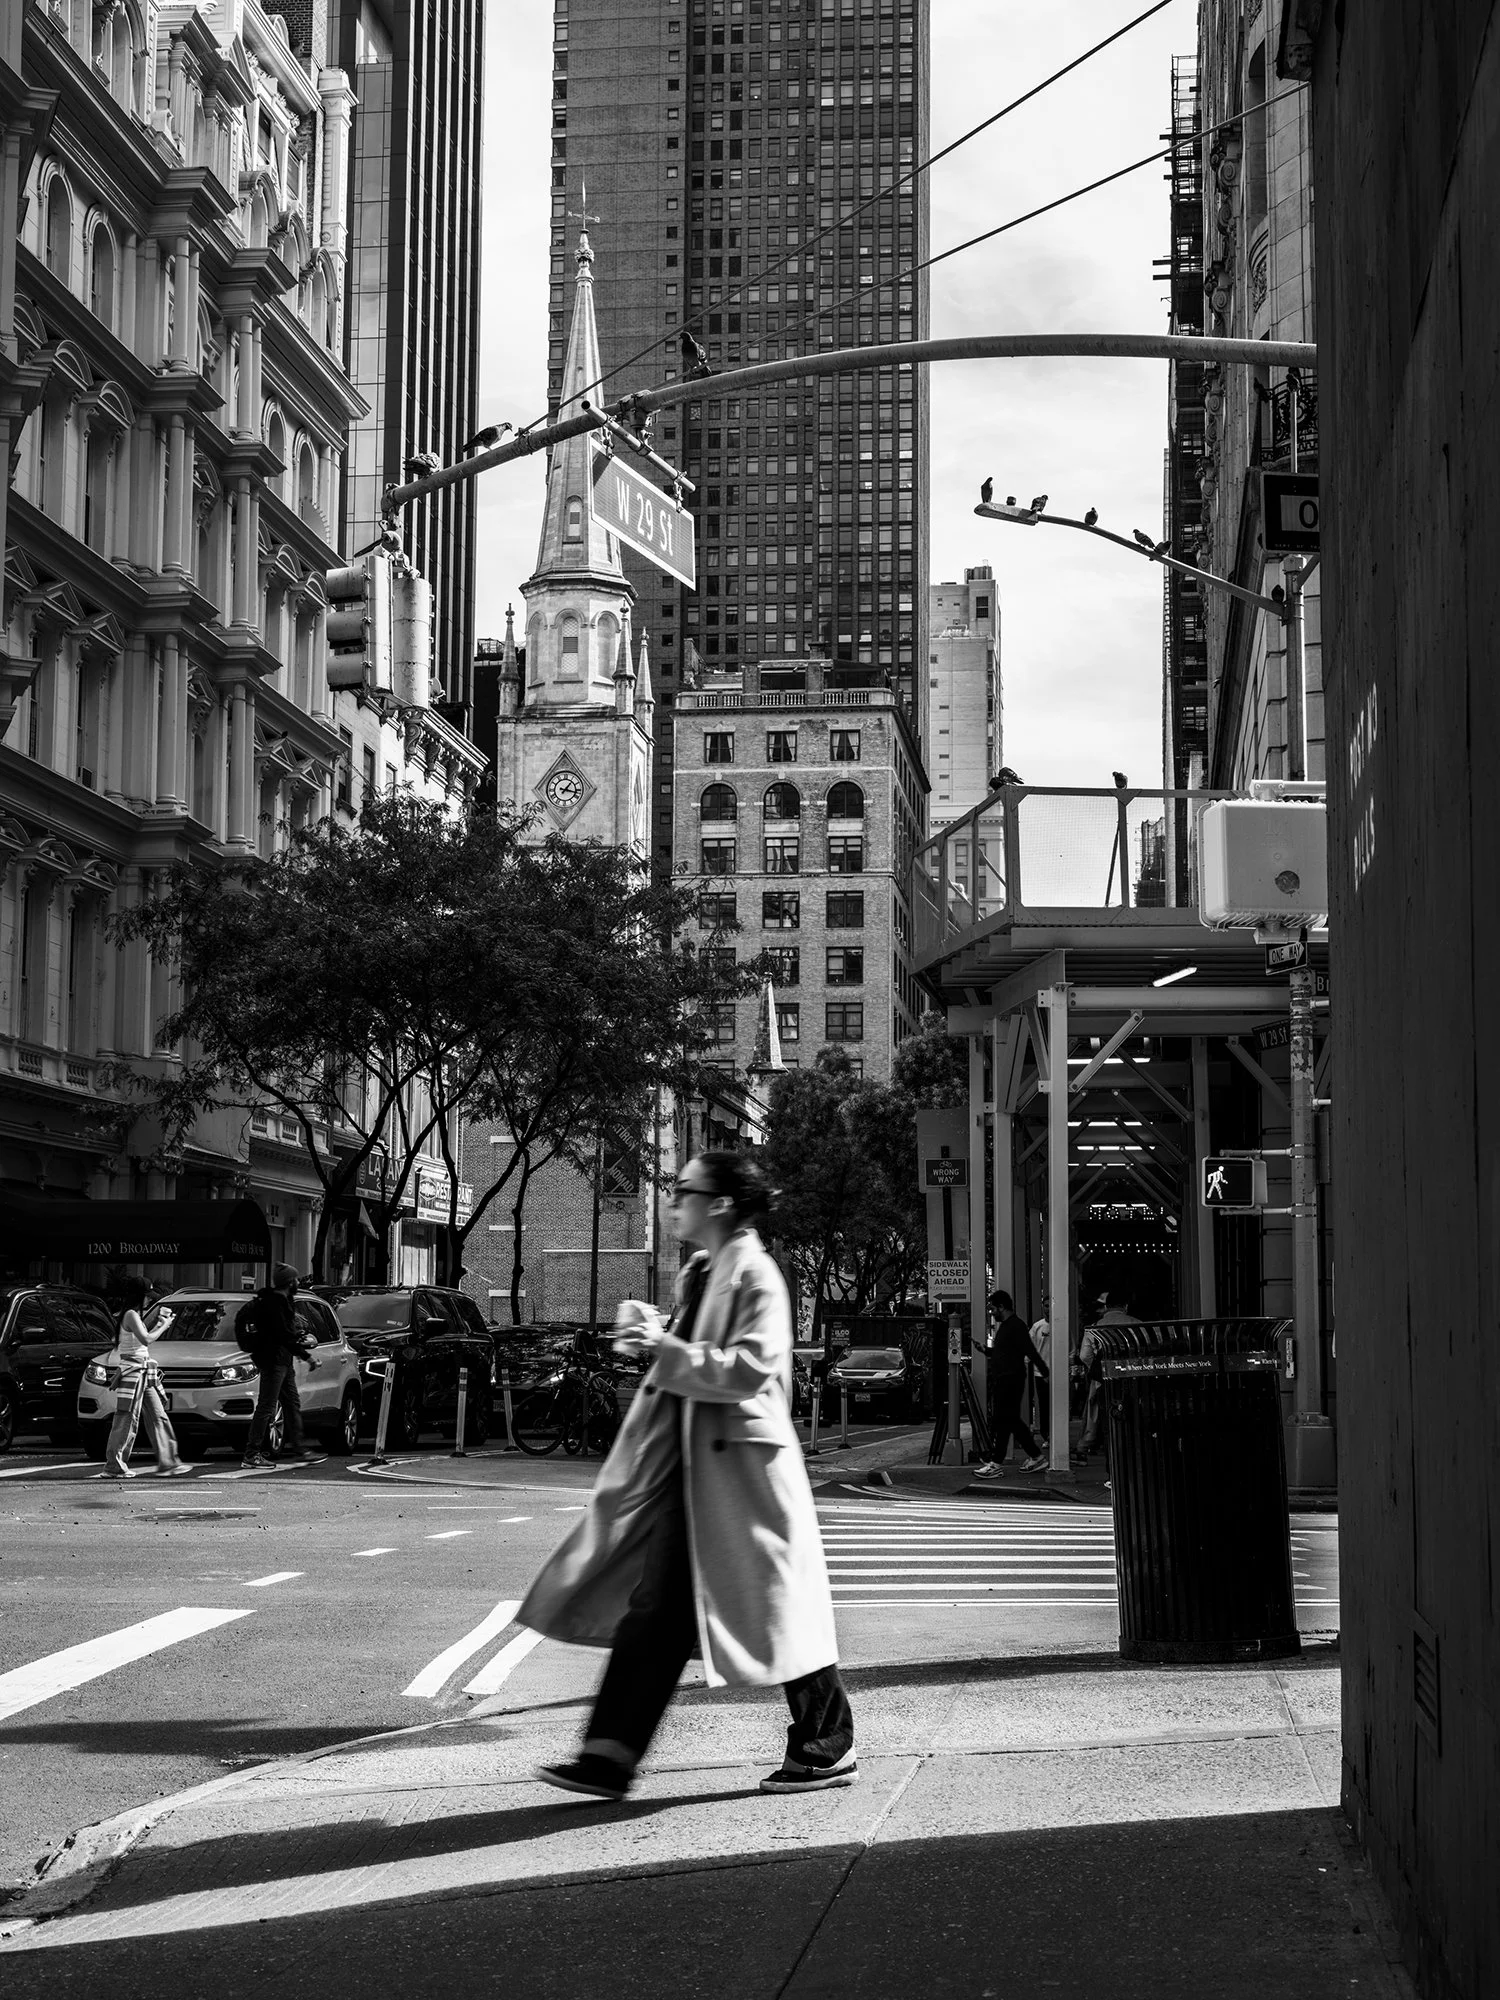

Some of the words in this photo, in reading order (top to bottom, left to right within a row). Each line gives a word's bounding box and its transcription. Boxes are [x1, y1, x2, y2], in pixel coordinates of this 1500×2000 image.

[616, 476, 629, 525] W
[637, 492, 653, 541] 29
[660, 510, 673, 556] St
[1350, 710, 1365, 800] POST
[1353, 797, 1375, 893] BILLS
[1271, 948, 1285, 964] ONE
[1289, 943, 1301, 959] WAY
[1259, 1031, 1268, 1048] W
[1268, 1029, 1278, 1046] 29
[1278, 1026, 1288, 1045] St
[933, 1168, 960, 1176] WRONG
[937, 1176, 955, 1184] WAY
[87, 1242, 112, 1255] 1200
[119, 1241, 181, 1255] BROADWAY
[929, 1269, 969, 1277] CLOSED
[1185, 1360, 1197, 1368] New
